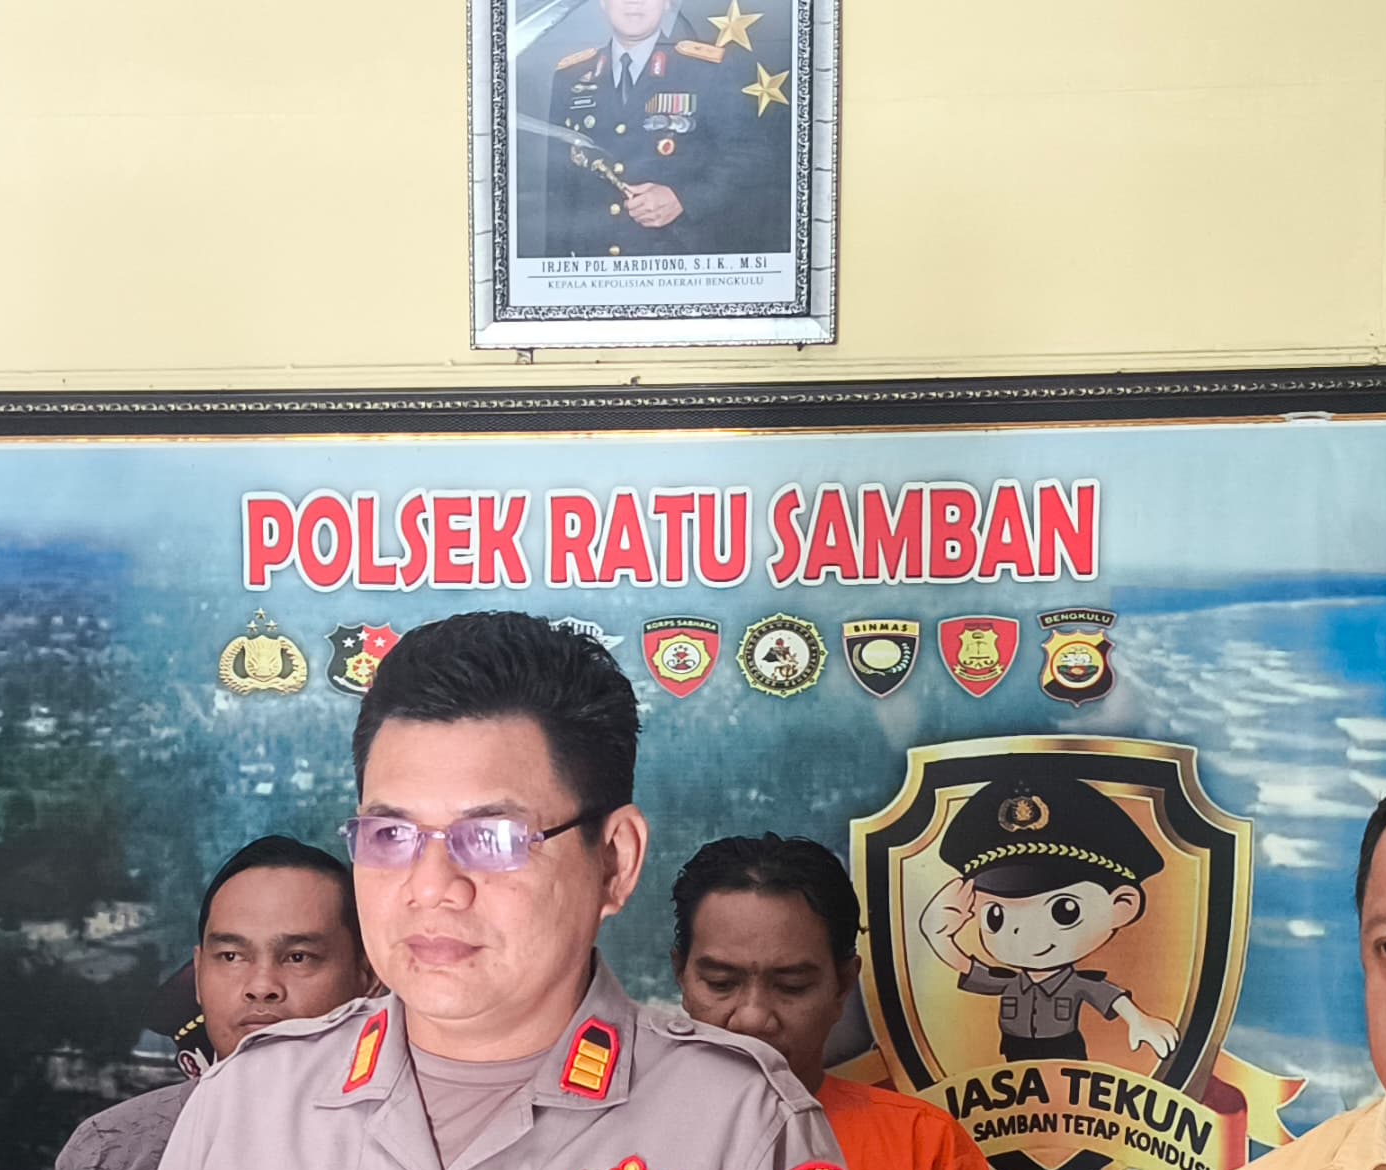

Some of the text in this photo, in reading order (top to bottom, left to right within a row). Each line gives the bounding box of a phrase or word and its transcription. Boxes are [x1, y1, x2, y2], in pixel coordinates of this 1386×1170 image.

[542, 260, 579, 273] IRJEN
[586, 260, 607, 272] POL
[548, 275, 764, 289] KEPALA KEPOLISIAN DAERAH BENGKULU
[243, 482, 1102, 591] POLSEK RATU SAMBAN
[1044, 614, 1111, 625] BENGKULU
[853, 624, 909, 633] BINMAS
[1060, 1068, 1213, 1156] TEKUN
[973, 1113, 1058, 1142] SAMBAN
[1062, 1113, 1120, 1141] TETAP
